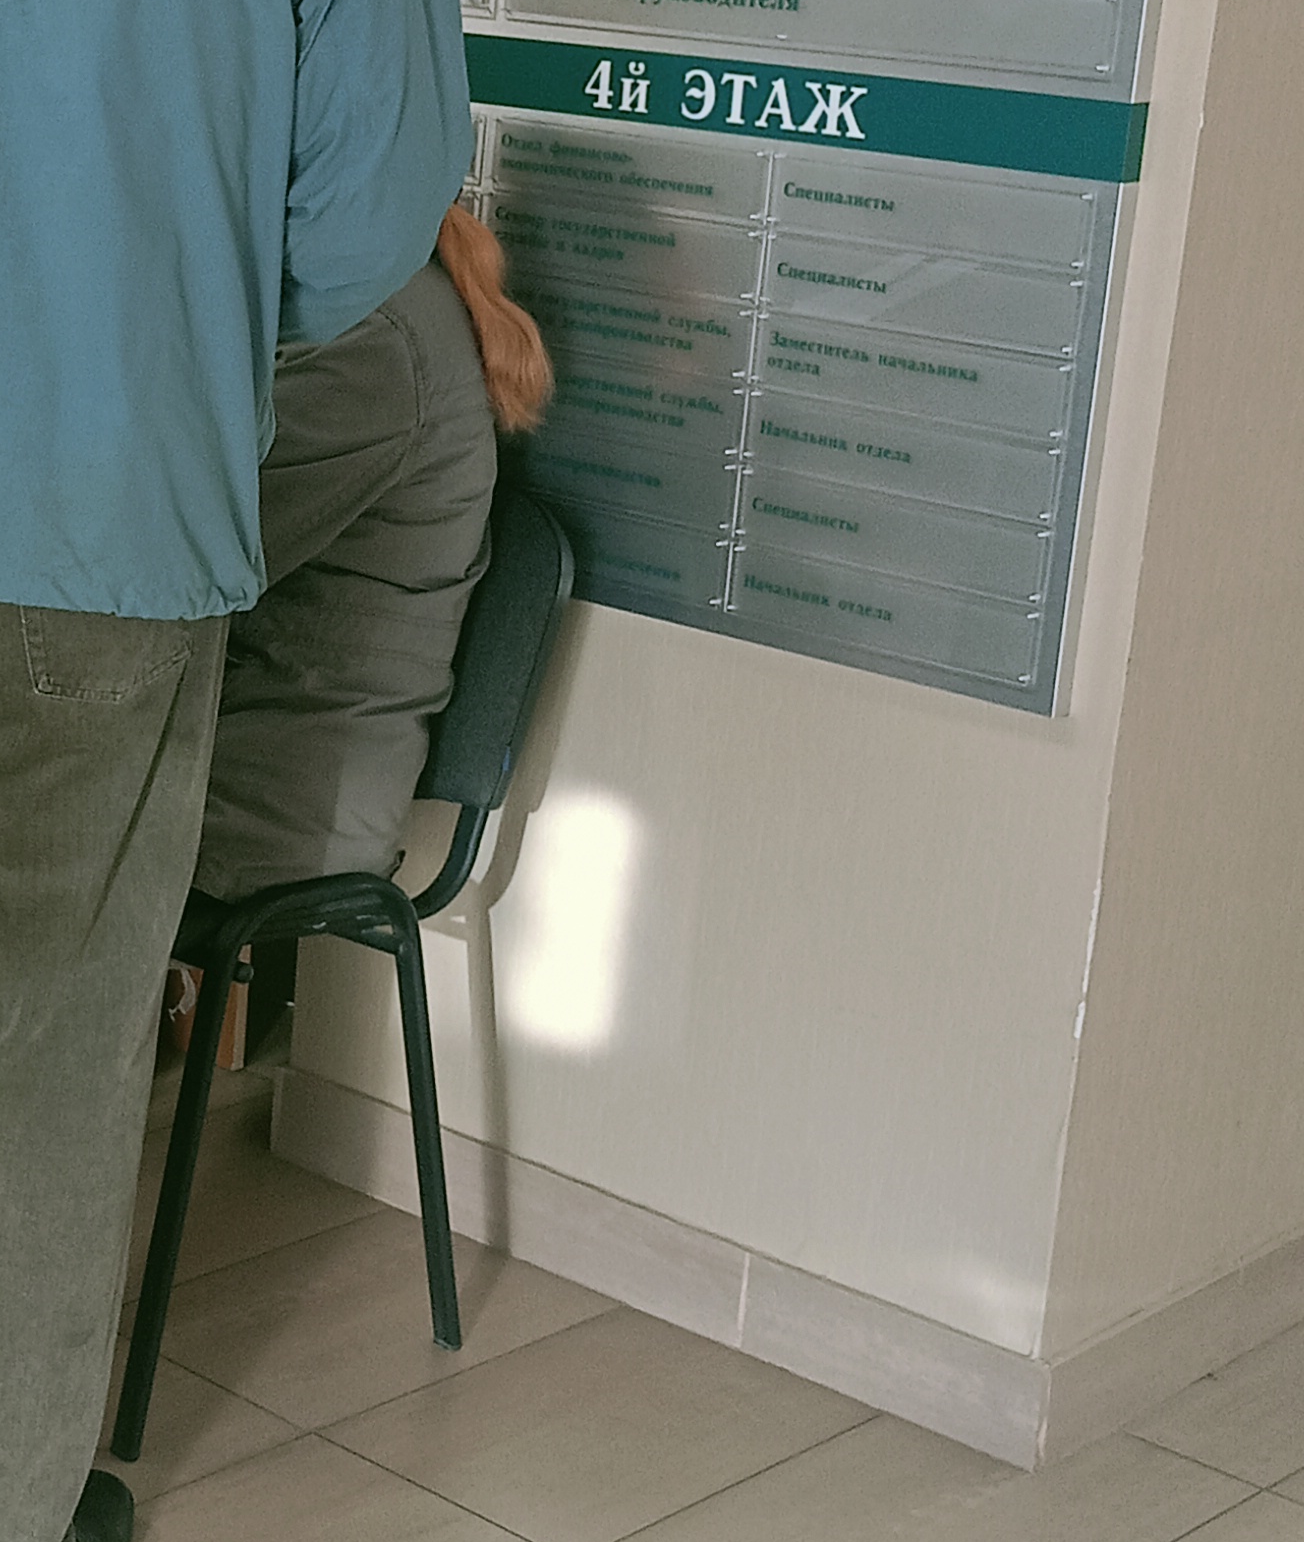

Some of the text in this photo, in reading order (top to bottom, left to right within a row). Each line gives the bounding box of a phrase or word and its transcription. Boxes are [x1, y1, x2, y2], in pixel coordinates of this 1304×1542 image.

[584, 60, 869, 139] 4й ЭТАЖ
[783, 181, 895, 212] Специалисты
[776, 261, 886, 294] Специалисты
[767, 356, 820, 376] отдела
[770, 330, 978, 382] Заместитель начальника
[759, 419, 912, 464] Начальник отдела
[752, 496, 860, 533] Специалисты
[743, 574, 893, 623] Начальник отдела
